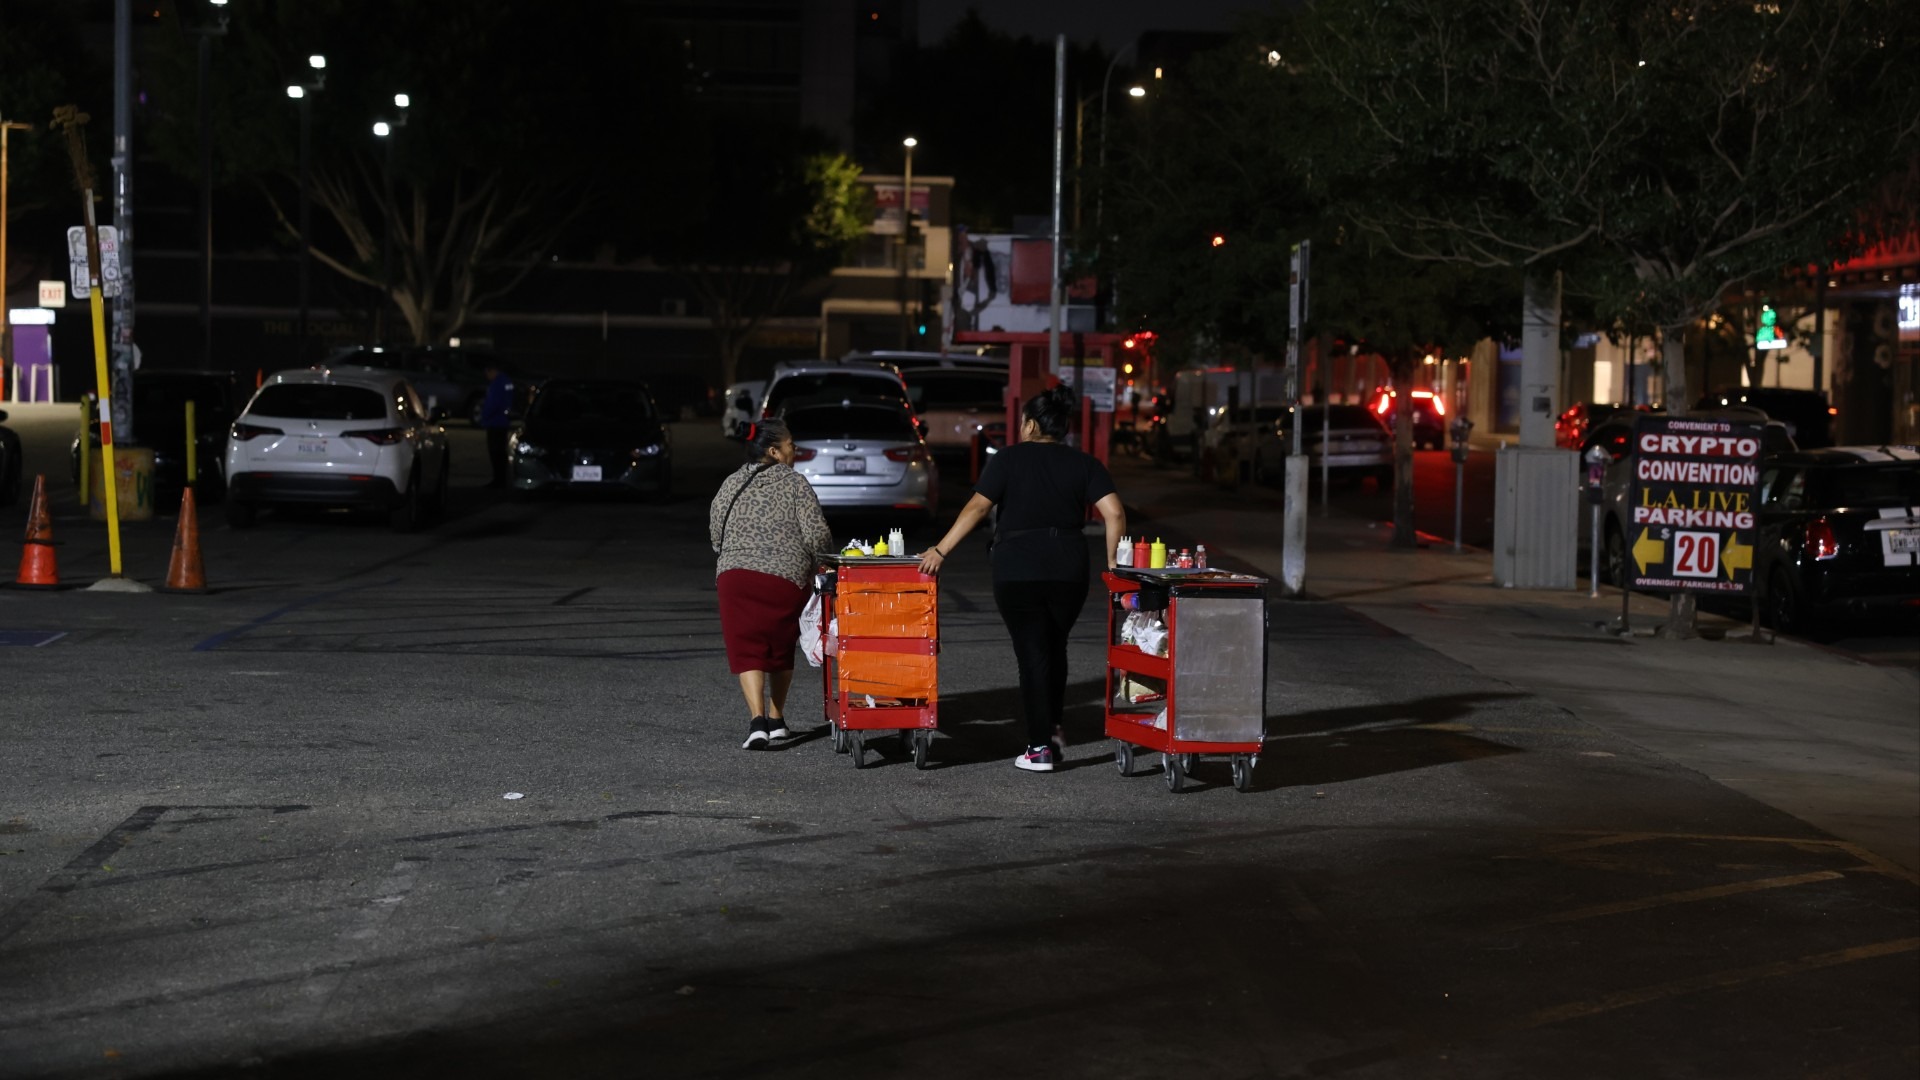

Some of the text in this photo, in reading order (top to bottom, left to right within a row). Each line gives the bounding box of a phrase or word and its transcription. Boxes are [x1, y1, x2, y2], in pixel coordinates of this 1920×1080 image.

[264, 320, 290, 334] THE
[1668, 420, 1731, 432] CONVENIENT TO
[1640, 434, 1757, 457] CRYPTO
[1638, 459, 1756, 485] CONVENTION
[1642, 487, 1750, 513] L.A. LIVE
[1634, 507, 1754, 529] PARKING
[1660, 527, 1716, 573] $ 20
[1635, 577, 1681, 588] OVERNIGHT
[1682, 579, 1717, 590] PARKING
